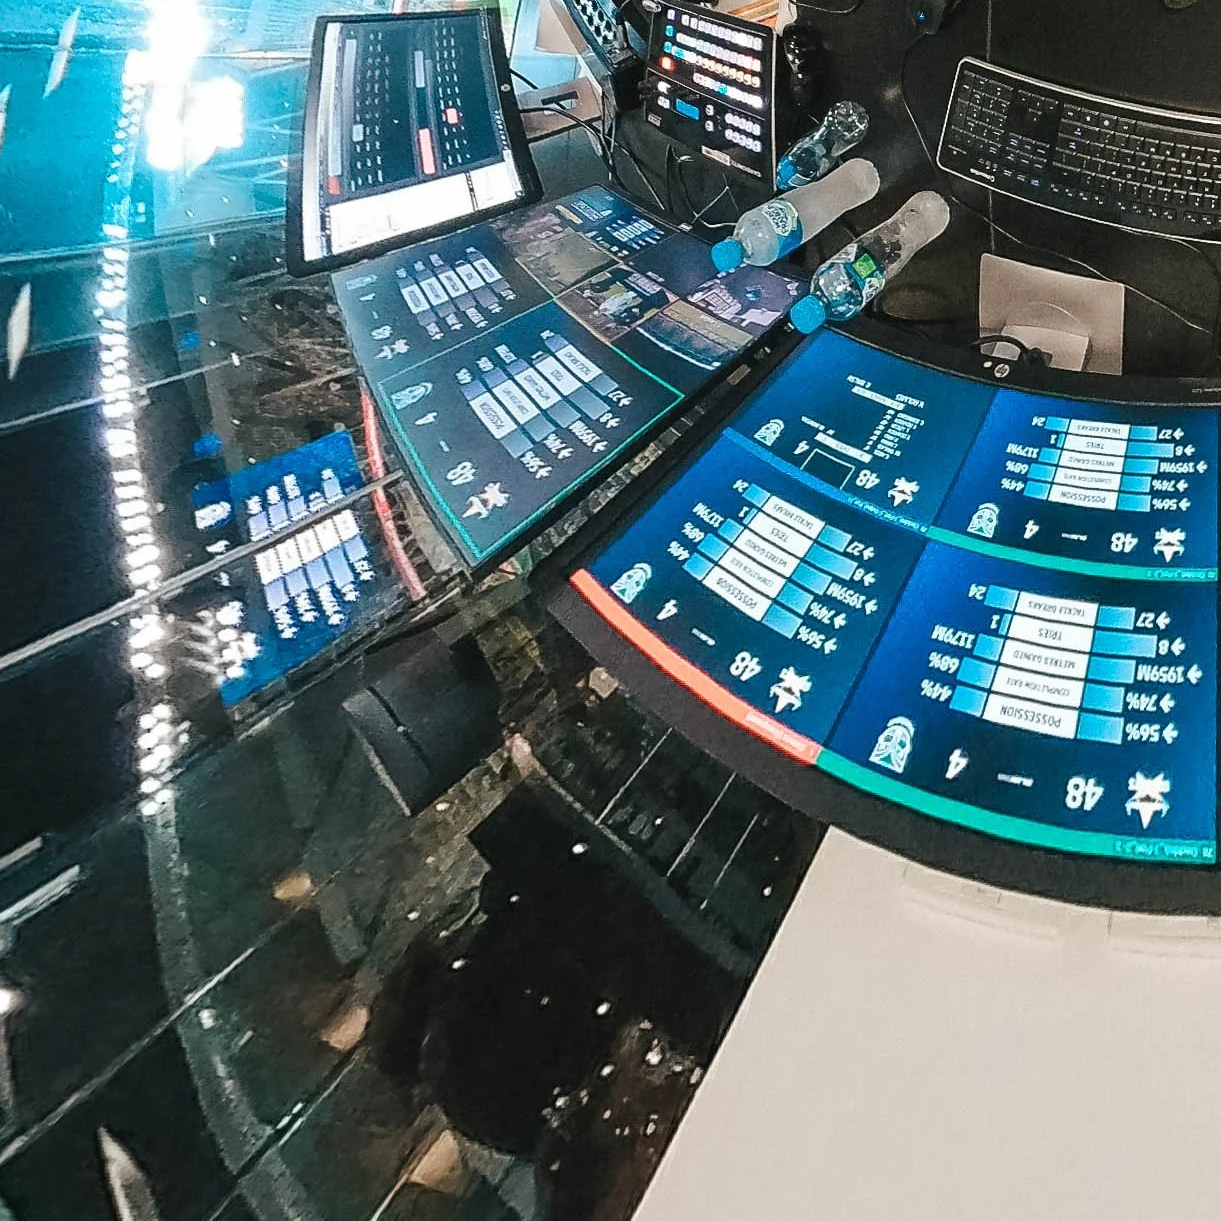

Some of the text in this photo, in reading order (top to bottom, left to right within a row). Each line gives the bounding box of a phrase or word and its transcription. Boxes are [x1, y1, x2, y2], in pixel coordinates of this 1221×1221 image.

[608, 390, 626, 401] 27
[415, 411, 438, 426] 4
[1032, 416, 1045, 426] 24
[1159, 429, 1172, 439] 27
[794, 441, 810, 455] 4
[1006, 442, 1039, 459] 1179M
[446, 461, 477, 485] 48
[1006, 460, 1029, 475] 68%
[1160, 461, 1194, 473] 1959M
[856, 469, 880, 489] 48
[1152, 479, 1175, 491] 74%
[1001, 478, 1176, 511] 56% POSSESSION 44%
[692, 502, 724, 528] 1179M
[682, 522, 705, 542] 68%
[1024, 519, 1138, 553] 48 4
[847, 541, 864, 555] 27
[667, 540, 825, 649] 56% POSSESSION 44%
[827, 582, 866, 609] 1959M
[968, 583, 985, 599] 24
[810, 602, 835, 623] 74%
[1136, 612, 1154, 627] 27
[657, 599, 762, 681] 48 4
[931, 624, 976, 649] 1179M
[991, 615, 1167, 655] 8 TRIES 1
[929, 652, 959, 673] 68%
[1137, 664, 1184, 682] 1959M
[921, 679, 1160, 742] 56% POSSESSION 44%
[1126, 692, 1157, 711] 74%
[945, 748, 1104, 811] 48 4
